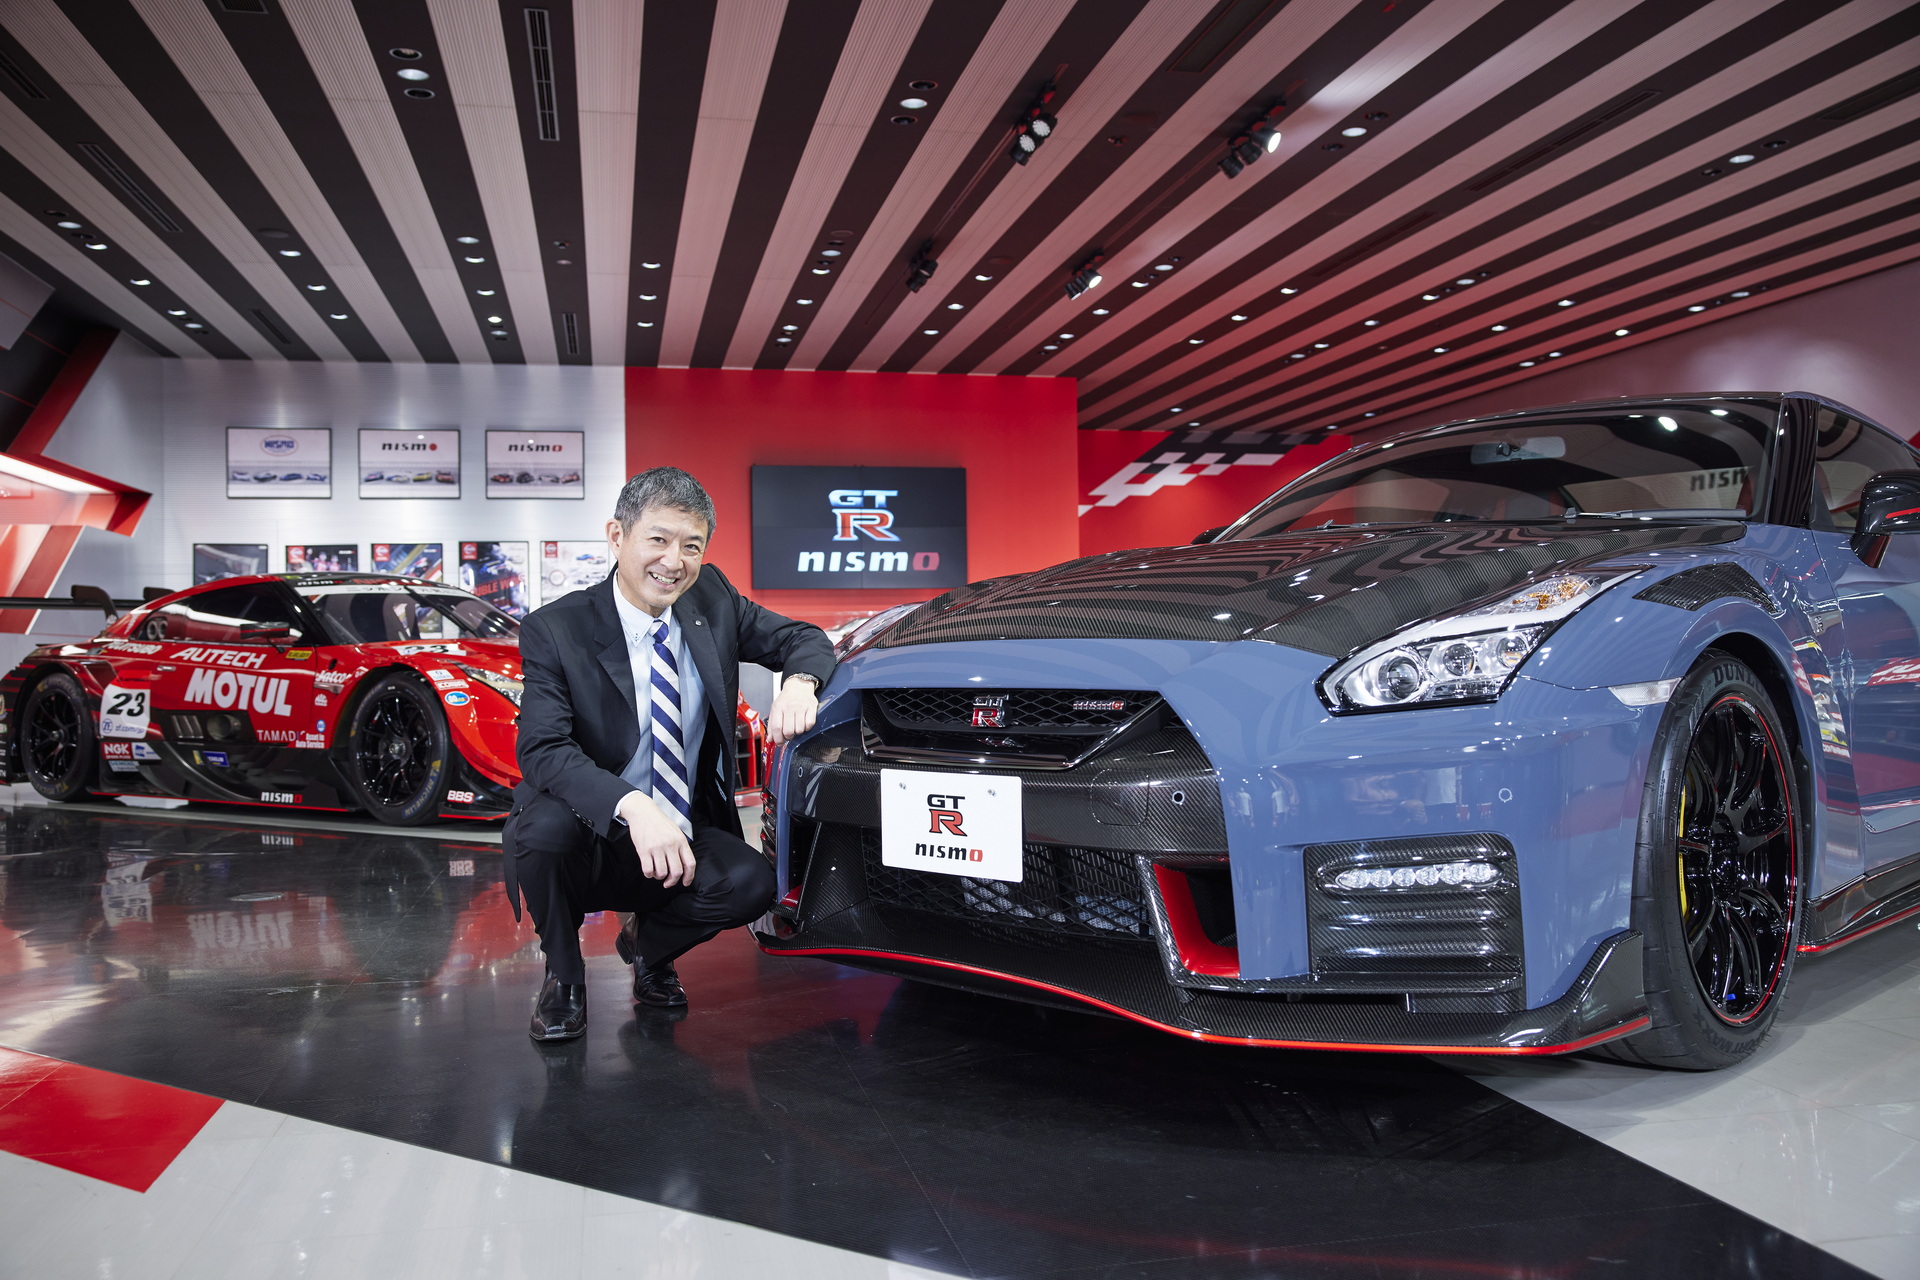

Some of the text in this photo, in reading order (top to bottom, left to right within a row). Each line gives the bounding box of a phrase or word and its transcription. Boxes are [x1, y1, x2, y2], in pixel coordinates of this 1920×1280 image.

[508, 443, 563, 453] nismo
[1691, 469, 1745, 491] nism
[828, 489, 899, 508] GT
[832, 508, 901, 541] R
[797, 551, 940, 572] nismo
[169, 647, 267, 669] AUTECH
[184, 667, 292, 716] MOTUL
[106, 692, 146, 717] 23
[104, 743, 130, 754] NGK
[261, 792, 303, 804] nismo
[447, 790, 475, 804] BBS
[927, 793, 966, 809] GT
[928, 808, 968, 837] R
[915, 843, 983, 862] nismo
